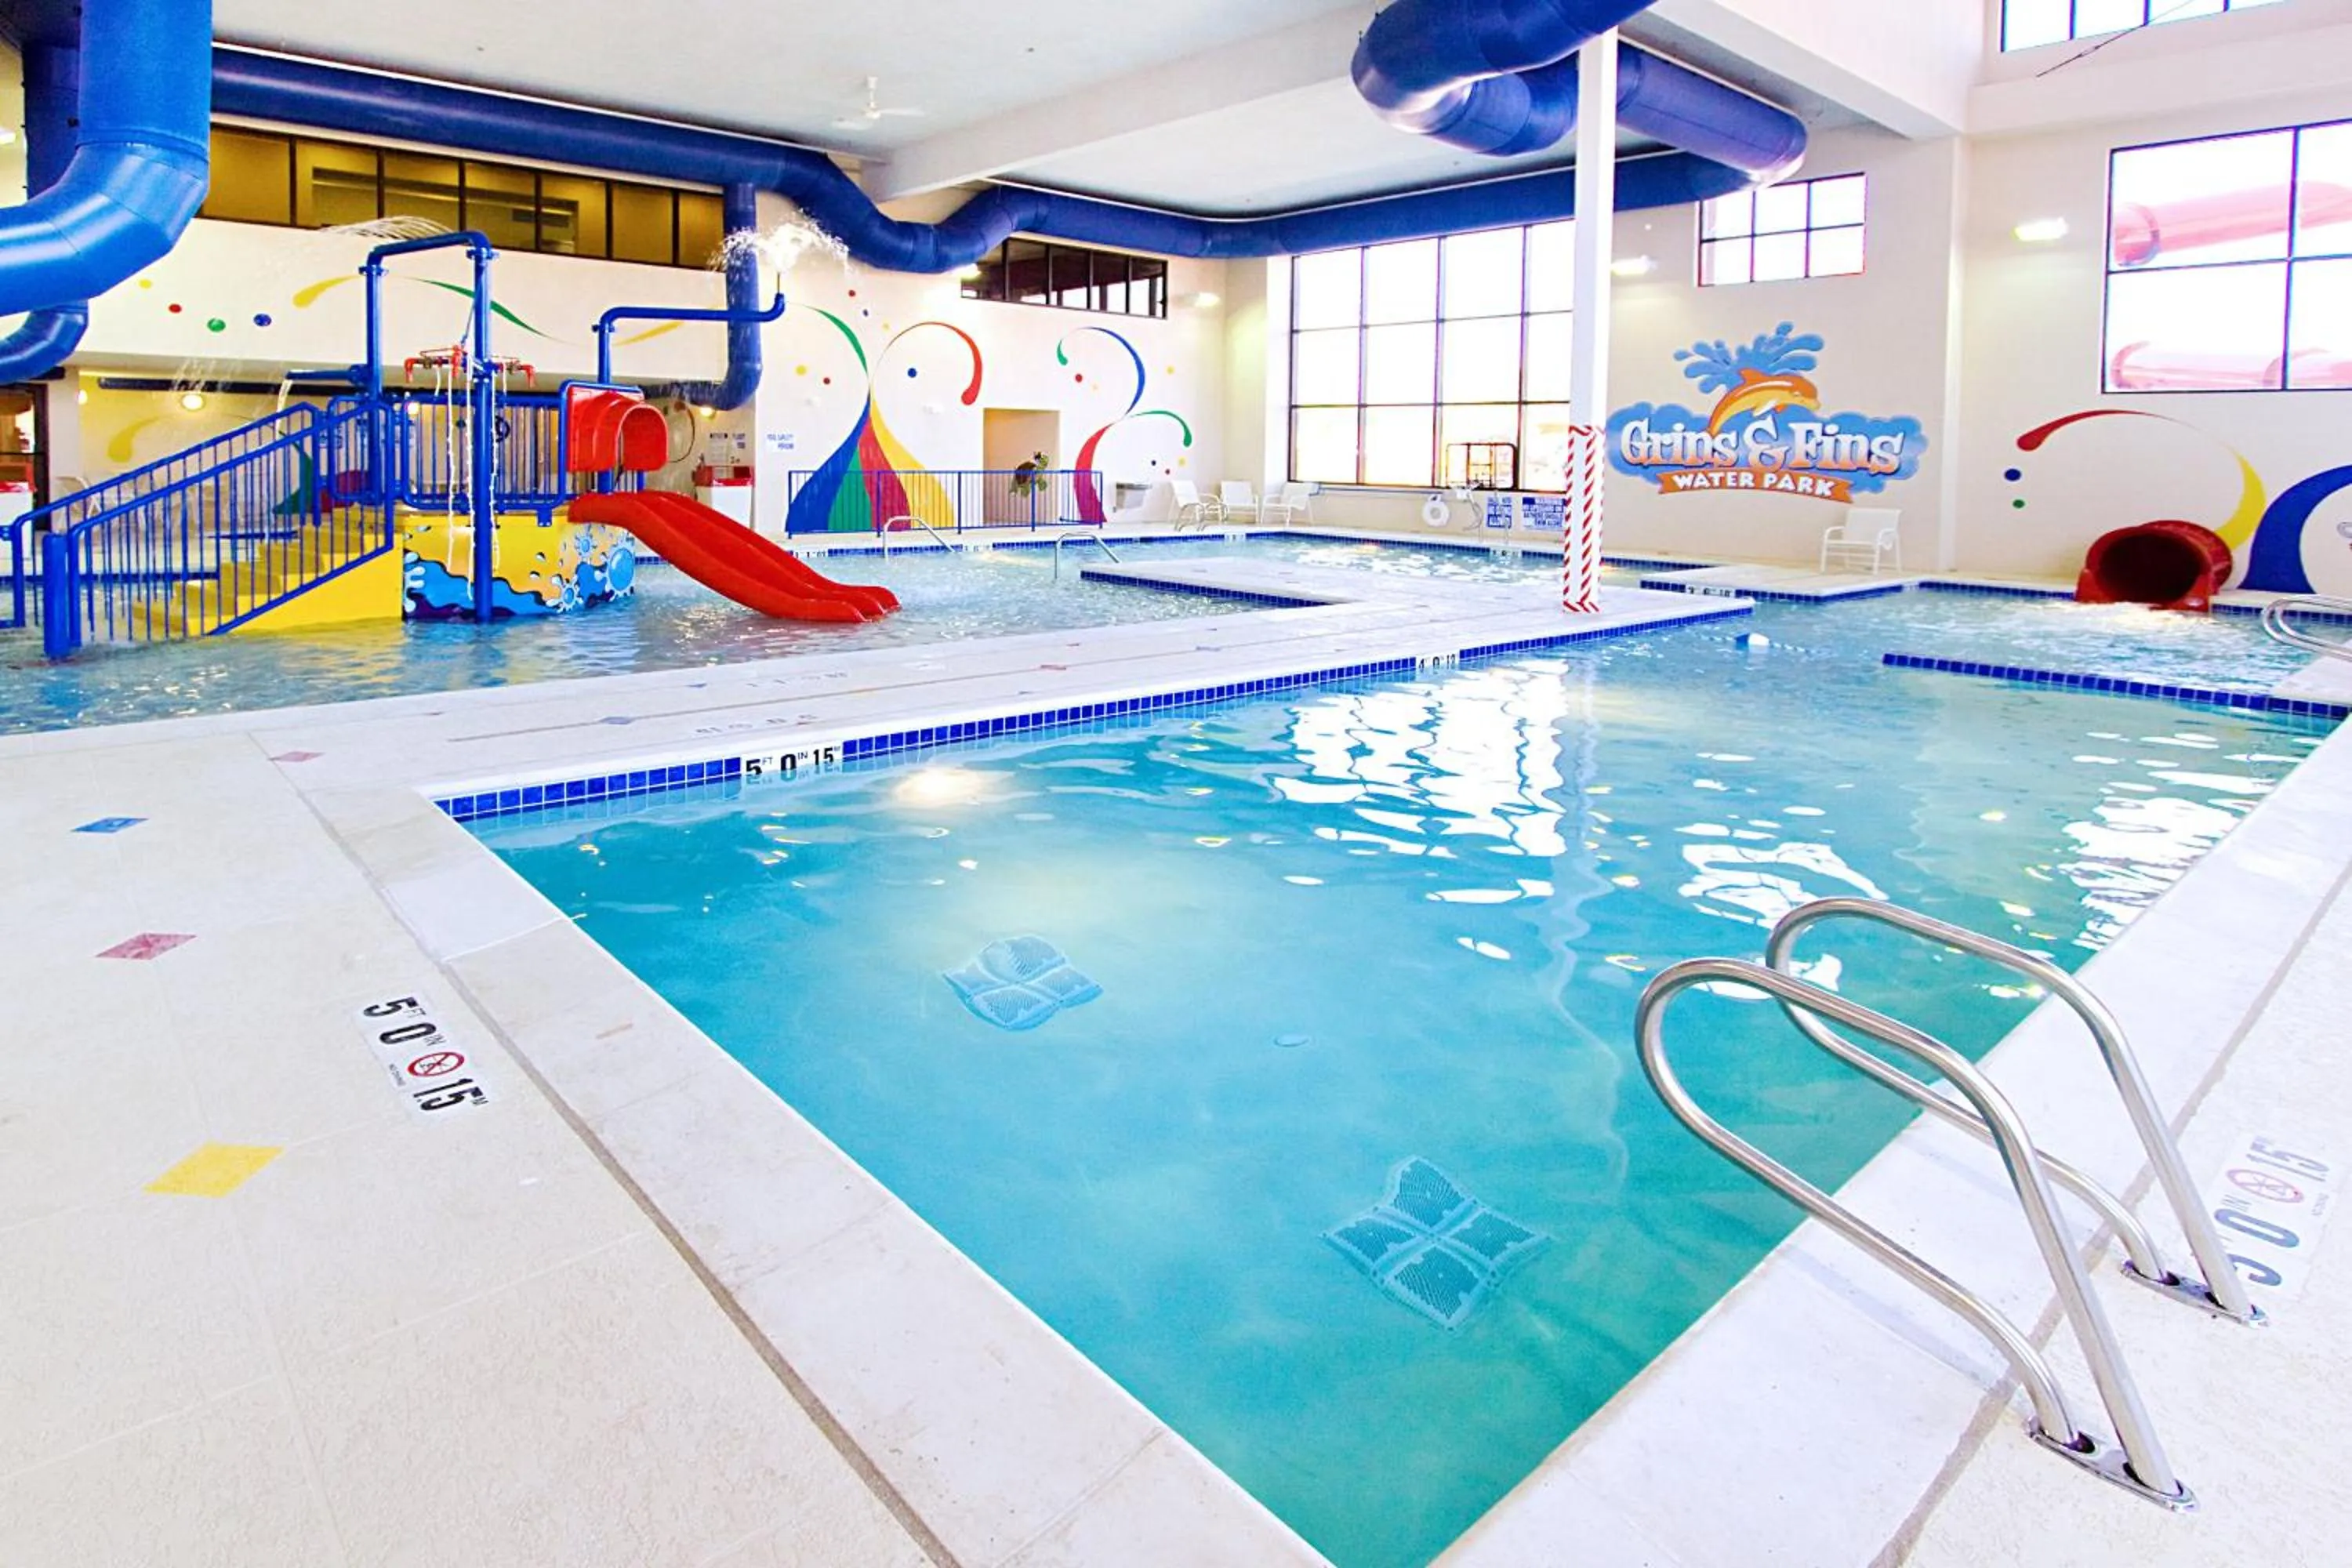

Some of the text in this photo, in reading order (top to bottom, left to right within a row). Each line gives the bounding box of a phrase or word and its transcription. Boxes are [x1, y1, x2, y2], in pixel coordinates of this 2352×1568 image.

[1621, 416, 1904, 475] Grins & Fins
[1672, 473, 1836, 497] WATER PARK
[363, 996, 419, 1017] 5
[379, 1022, 437, 1044] 0
